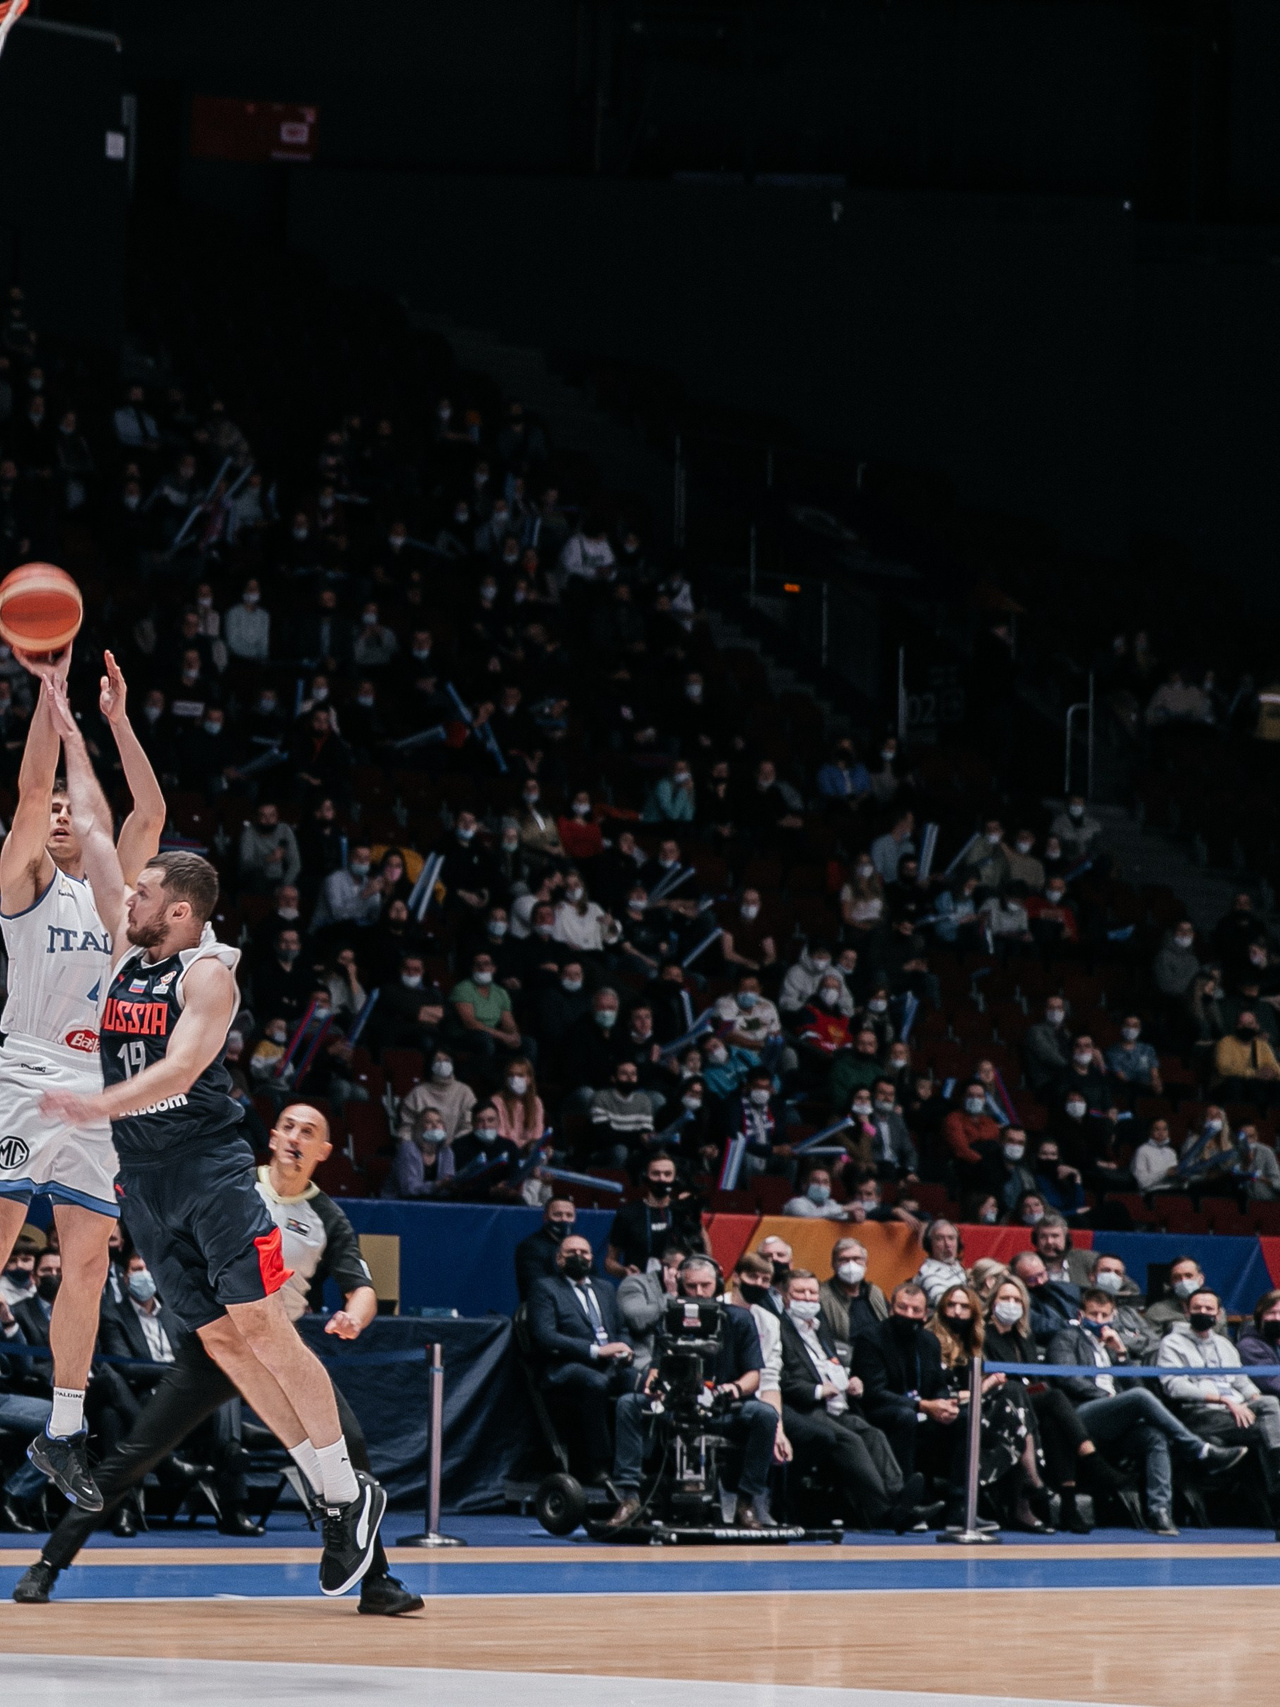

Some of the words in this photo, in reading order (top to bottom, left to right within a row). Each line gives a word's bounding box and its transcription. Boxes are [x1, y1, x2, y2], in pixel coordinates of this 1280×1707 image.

[46, 924, 113, 956] ITAL
[103, 997, 169, 1036] USSIA
[117, 1040, 147, 1082] 19
